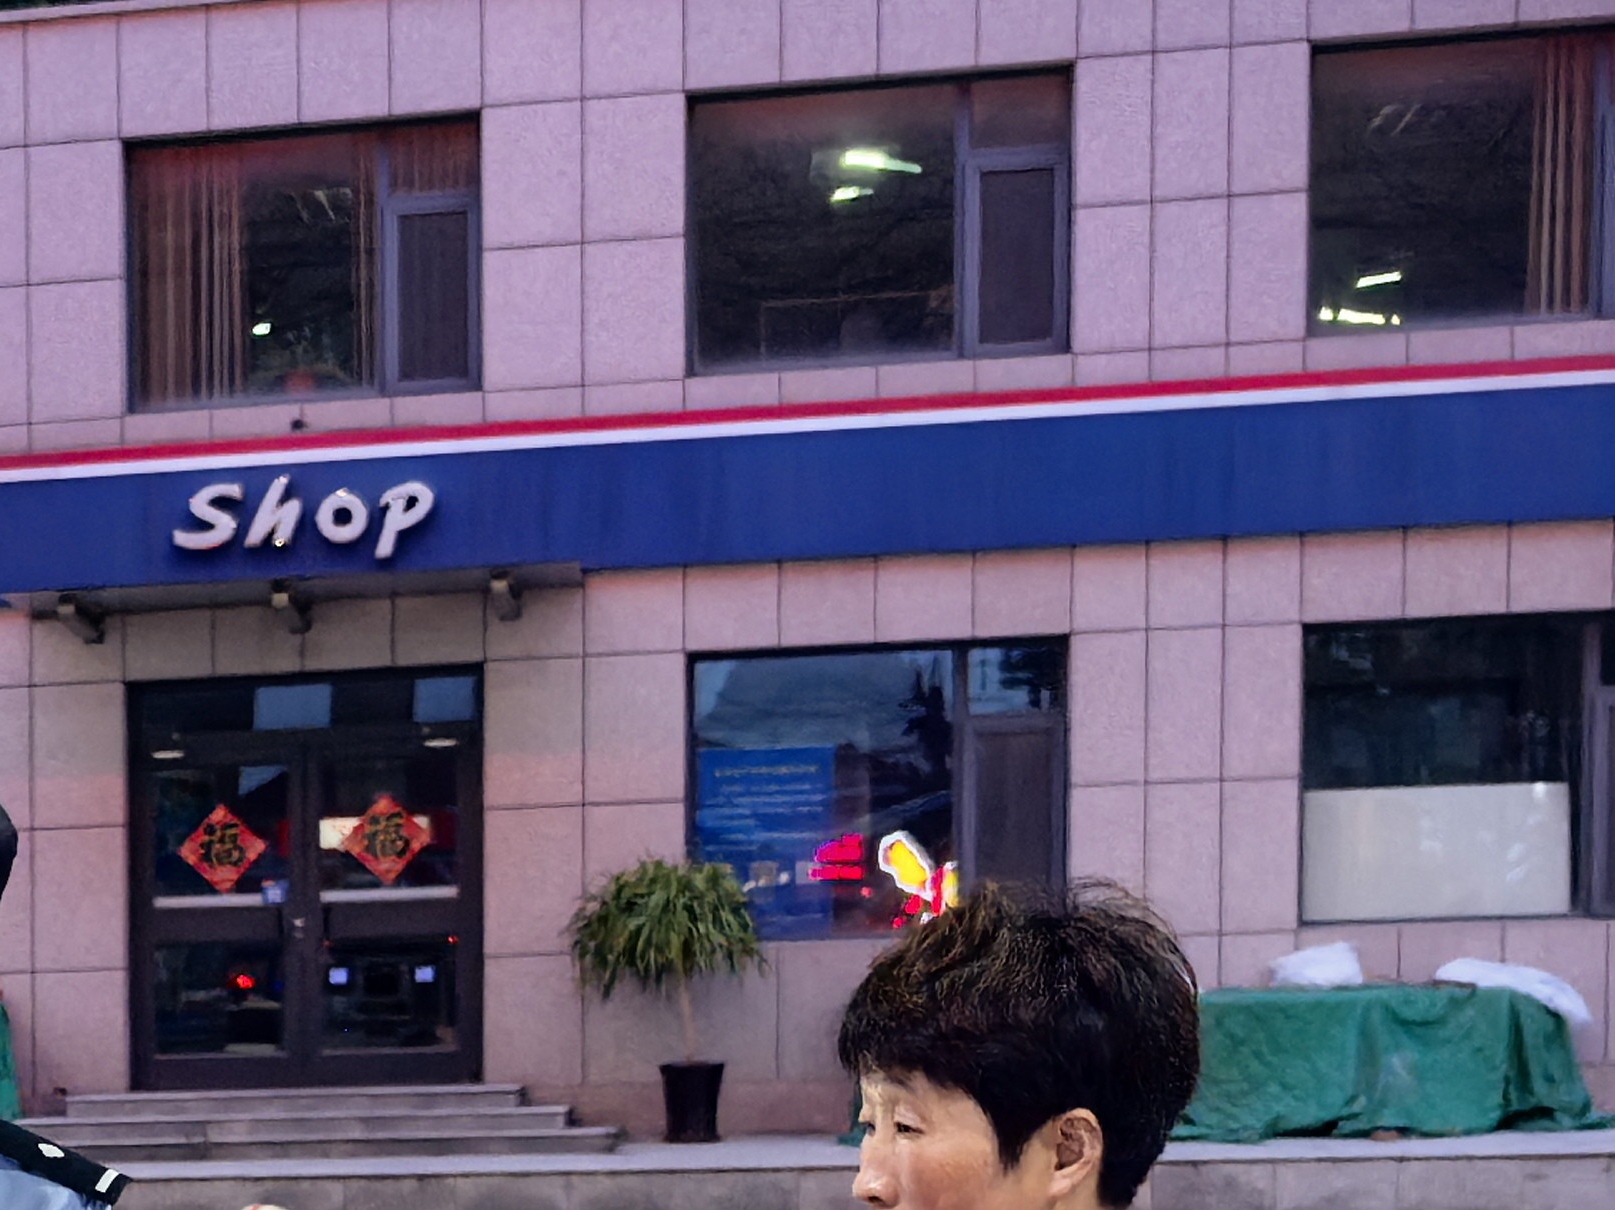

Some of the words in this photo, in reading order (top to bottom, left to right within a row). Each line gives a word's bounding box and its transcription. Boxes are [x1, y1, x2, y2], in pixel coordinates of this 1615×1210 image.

[173, 475, 434, 559] Shop
[199, 821, 246, 868] 福
[363, 811, 411, 860] 福
